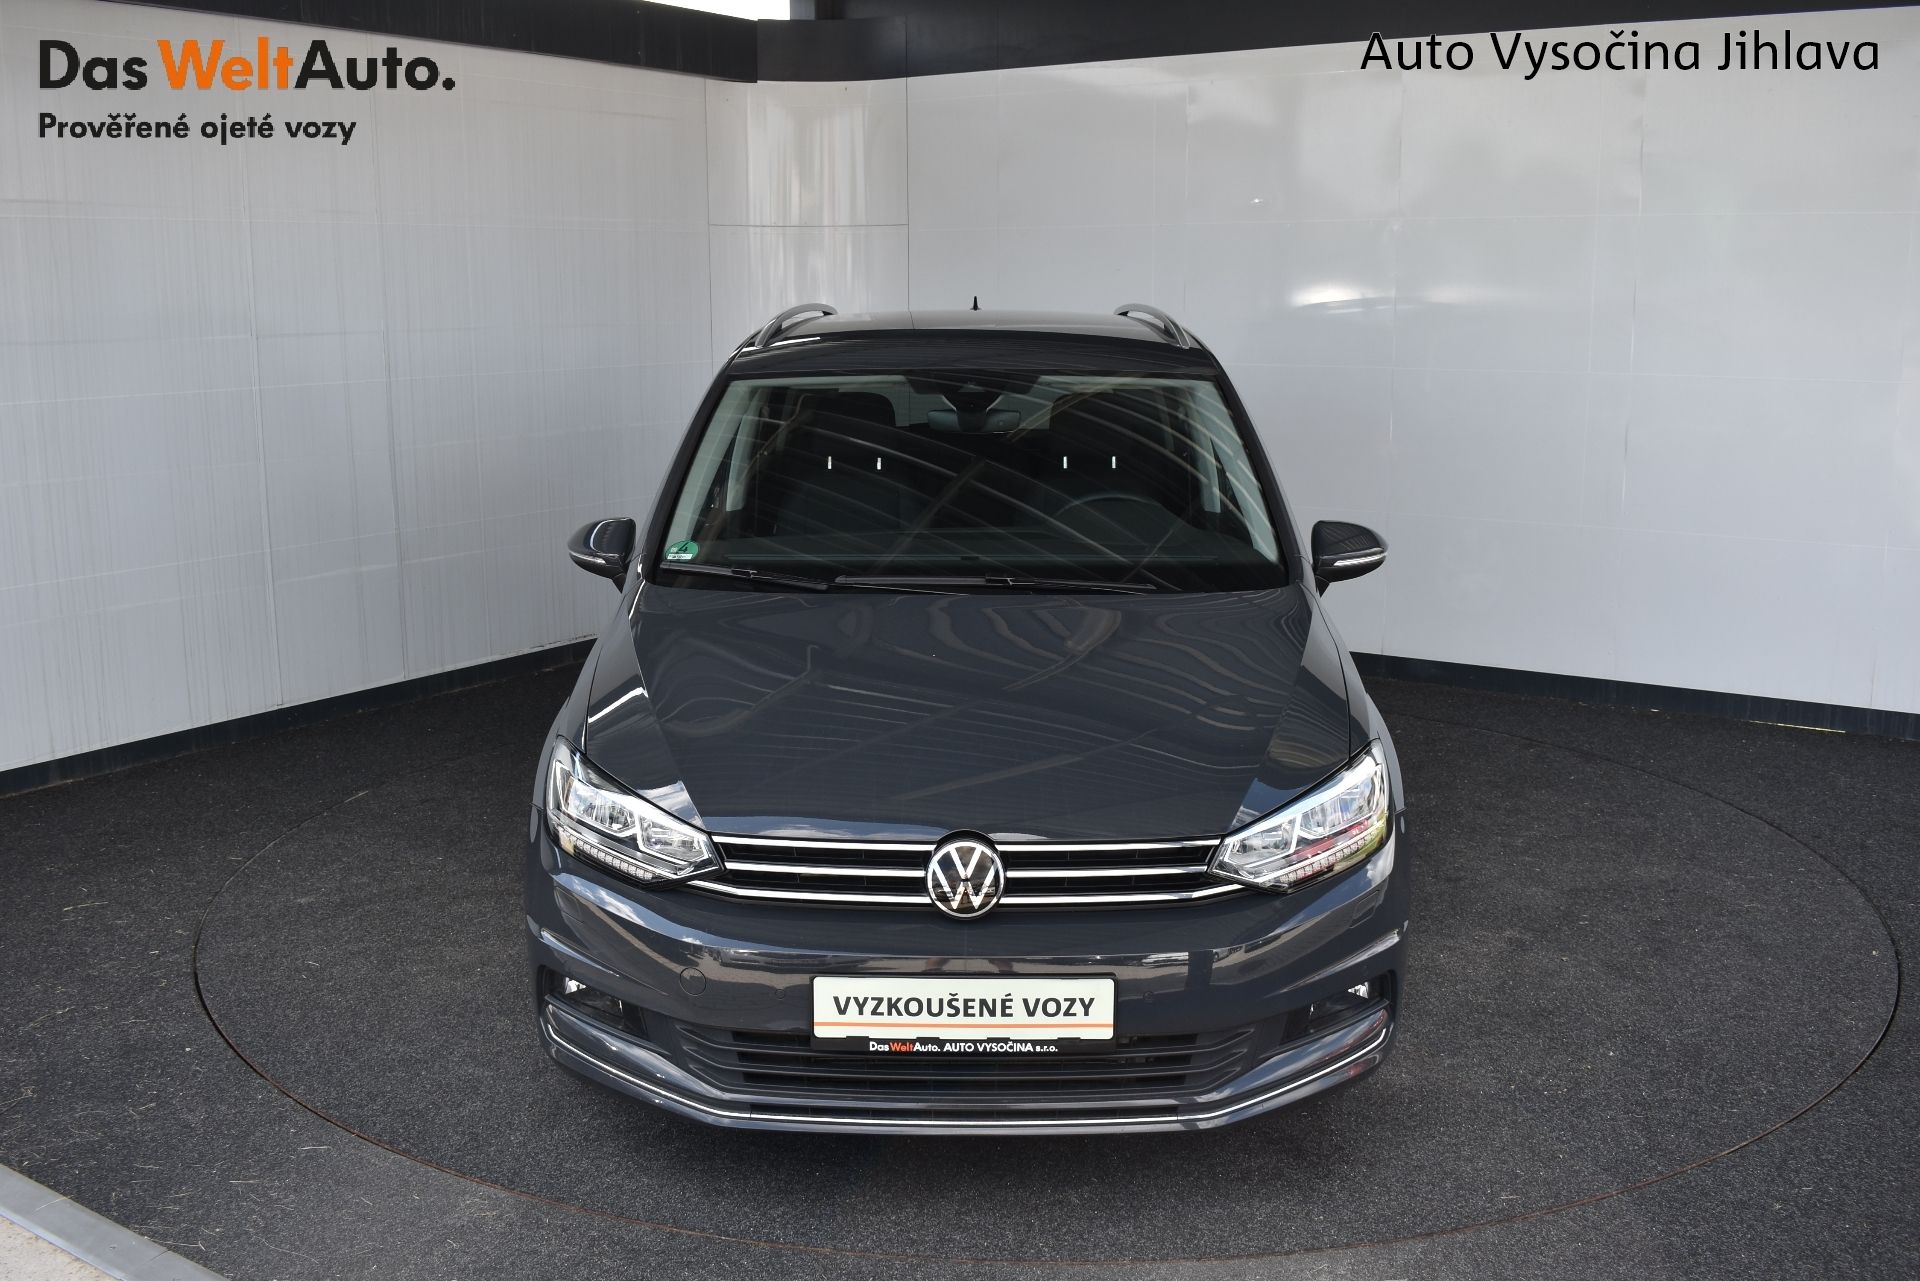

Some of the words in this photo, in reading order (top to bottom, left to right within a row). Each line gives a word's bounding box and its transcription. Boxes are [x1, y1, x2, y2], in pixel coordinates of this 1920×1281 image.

[833, 993, 1013, 1018] VYZKOUŠENÉ
[1022, 996, 1096, 1017] VOZY
[943, 1042, 975, 1053] AUTO
[977, 1039, 1034, 1053] VYSOČINA
[1035, 1044, 1058, 1053] s.r.o.
